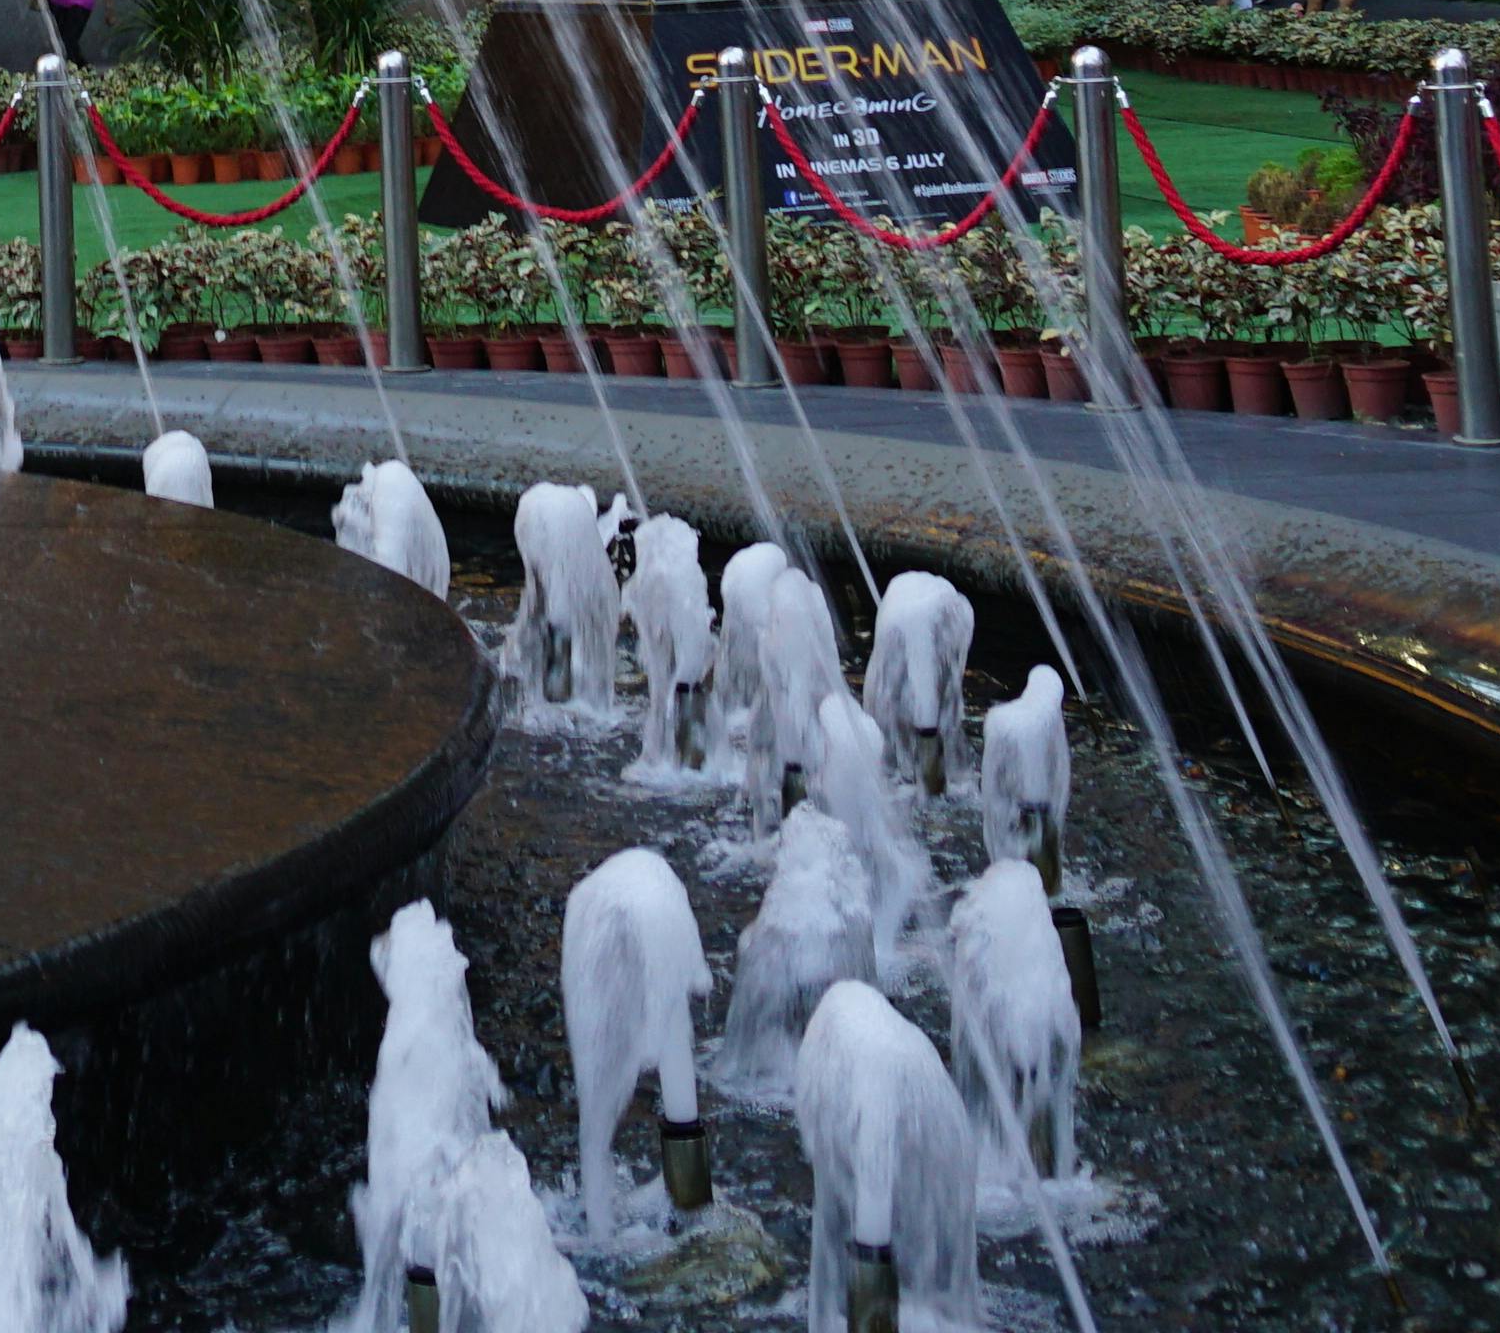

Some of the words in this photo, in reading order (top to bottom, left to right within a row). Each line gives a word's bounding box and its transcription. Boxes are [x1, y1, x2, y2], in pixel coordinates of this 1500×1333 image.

[686, 37, 989, 89] SIDER-MAN
[832, 132, 850, 148] IN
[852, 127, 880, 147] 3D
[776, 163, 797, 179] IN
[806, 157, 883, 177] INEMAS
[886, 155, 901, 171] 6
[903, 152, 946, 170] JULY
